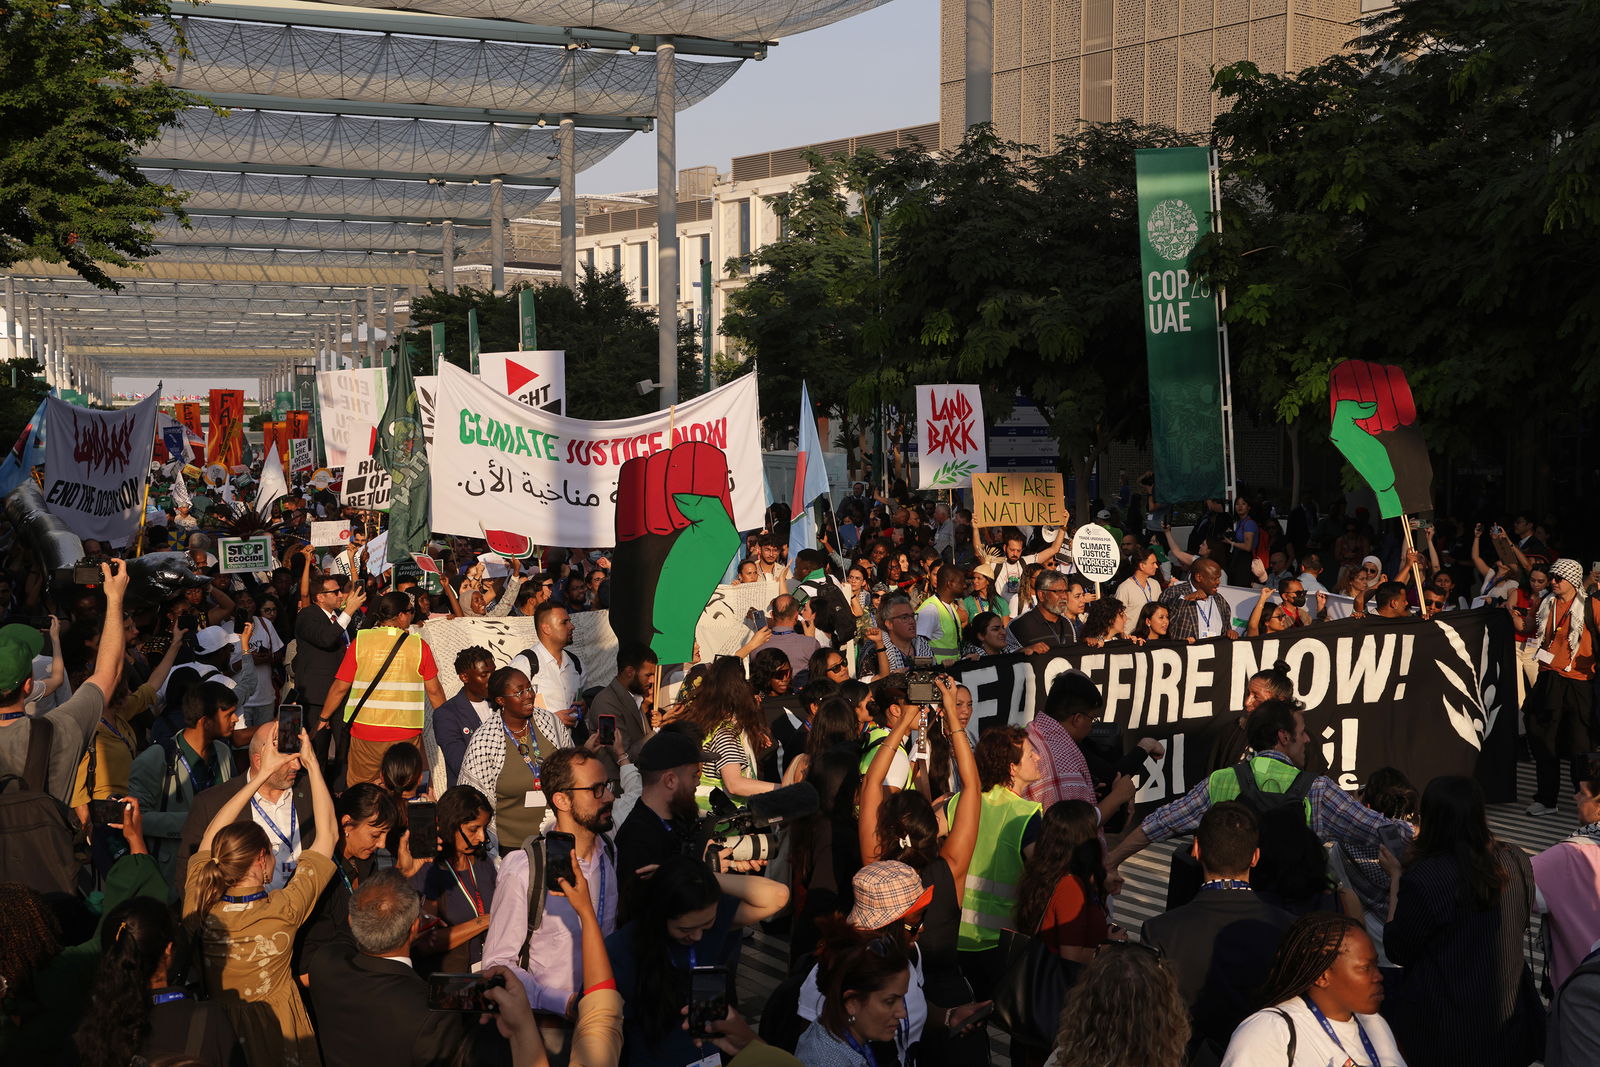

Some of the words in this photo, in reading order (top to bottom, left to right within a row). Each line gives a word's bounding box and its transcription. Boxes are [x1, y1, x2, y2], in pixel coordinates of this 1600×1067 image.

[1149, 302, 1191, 334] UAE
[518, 383, 551, 406] GHT
[929, 389, 973, 429] LAND
[296, 440, 306, 448] END
[459, 408, 560, 461] CLIMATE
[566, 431, 663, 465] JUSTICE
[671, 417, 727, 450] NOW
[926, 419, 979, 458] BACK
[296, 447, 306, 455] THE
[369, 473, 389, 489] OF
[522, 471, 600, 507] مناخية
[978, 475, 1010, 497] WE
[1023, 476, 1056, 498] ARE
[46, 480, 80, 507] END
[76, 483, 96, 513] THE
[348, 489, 390, 507] RETU
[983, 501, 1060, 523] NATURE
[228, 544, 263, 555] STOP
[1080, 542, 1111, 551] CLIMATE
[1083, 550, 1110, 558] JUSTICE
[1084, 565, 1113, 575] JUSTICE
[959, 643, 1218, 729] EAEFIRE
[1229, 633, 1416, 712] NOW!
